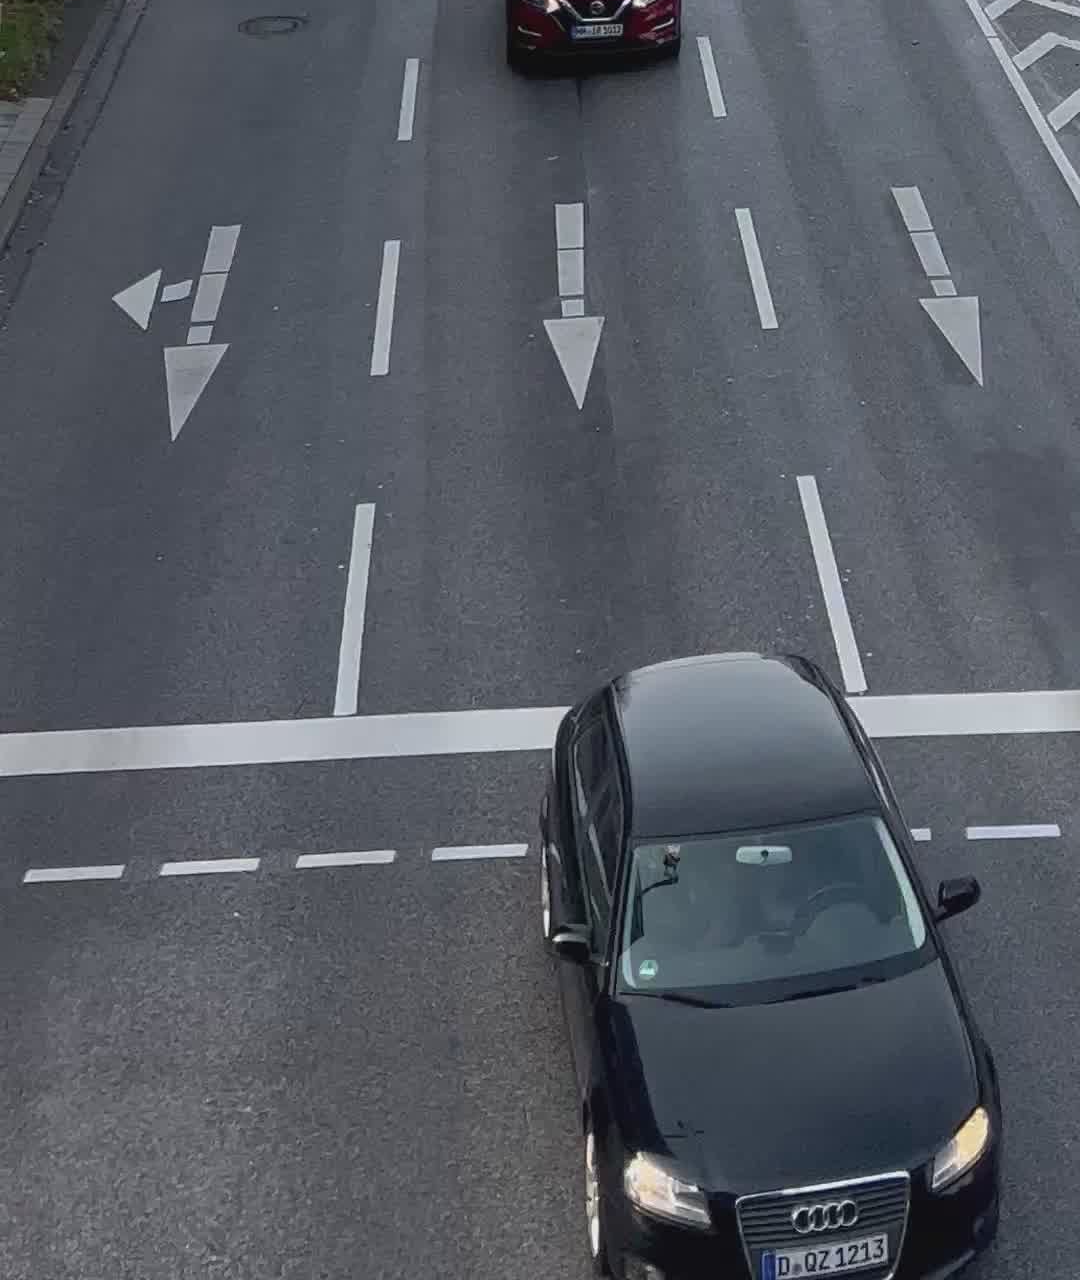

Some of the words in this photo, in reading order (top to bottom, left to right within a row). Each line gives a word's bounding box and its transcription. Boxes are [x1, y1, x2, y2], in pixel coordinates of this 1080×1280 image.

[778, 1256, 791, 1276] D
[804, 1250, 831, 1272] QZ
[835, 1239, 885, 1269] 1213
